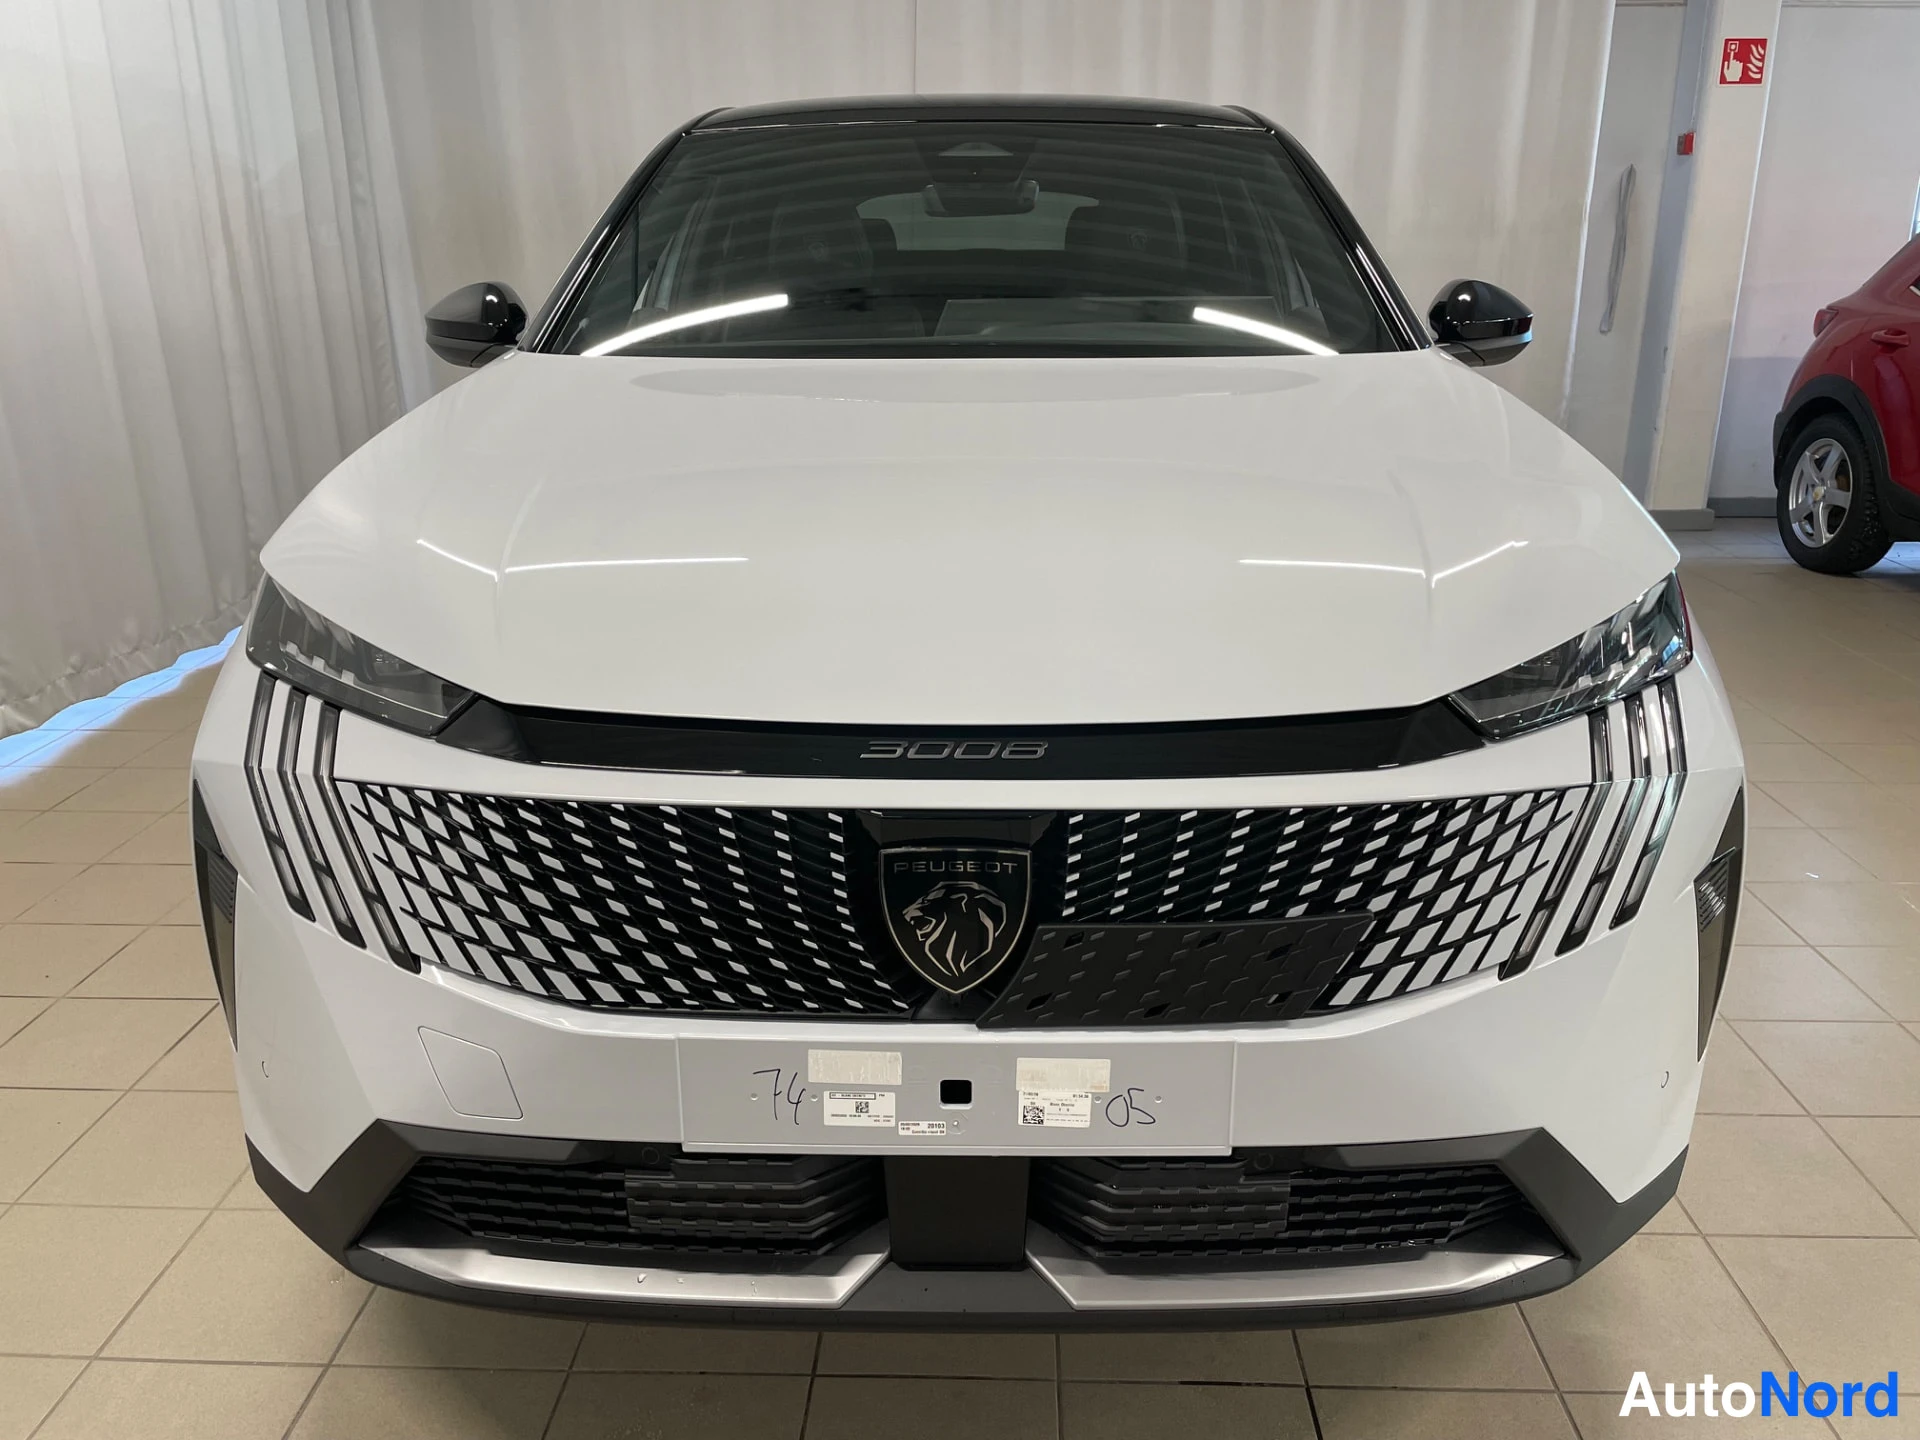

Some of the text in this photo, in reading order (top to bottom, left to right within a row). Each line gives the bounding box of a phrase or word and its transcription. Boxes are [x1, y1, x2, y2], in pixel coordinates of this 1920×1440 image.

[860, 741, 1049, 759] 3008
[893, 860, 1018, 874] PEUGEOT
[753, 1069, 806, 1125] 74
[1105, 1088, 1156, 1127] 05
